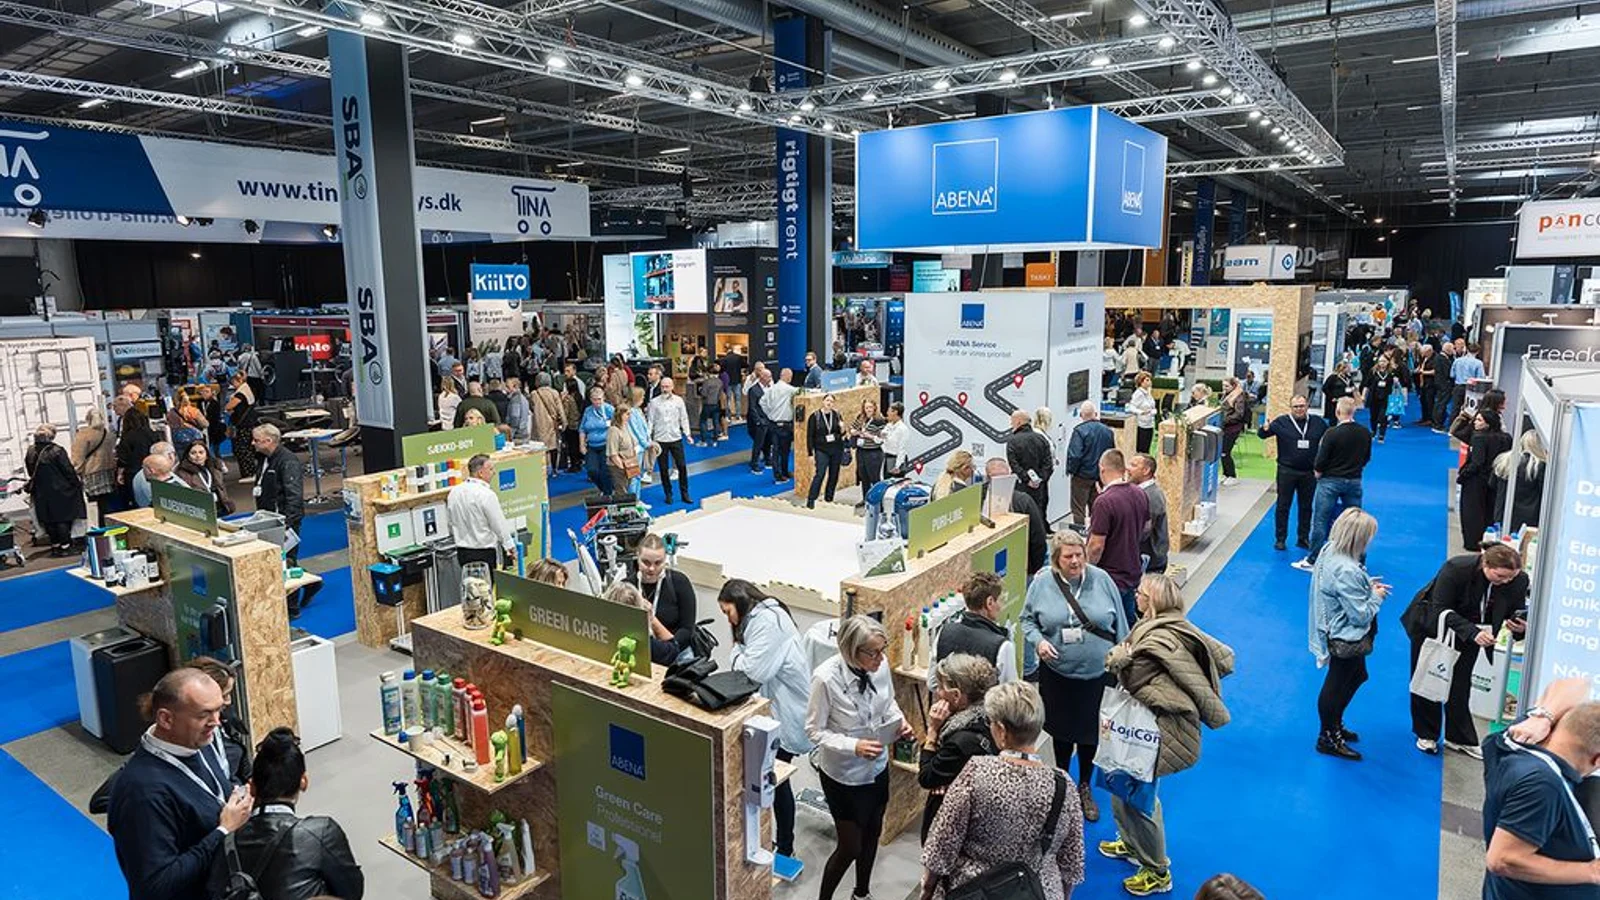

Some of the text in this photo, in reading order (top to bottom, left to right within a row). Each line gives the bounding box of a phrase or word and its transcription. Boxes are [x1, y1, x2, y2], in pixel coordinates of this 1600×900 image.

[342, 95, 363, 180] SBA
[511, 185, 556, 217] TINA
[782, 140, 800, 259] rigtigt rent
[935, 188, 993, 209] ABENA
[357, 286, 378, 365] SBA
[946, 340, 997, 349] ABENA Service
[1567, 557, 1599, 574] har
[1565, 575, 1596, 593] 100
[529, 605, 609, 645] GREEN CARE
[1559, 613, 1593, 628] gør
[611, 755, 644, 776] ABENA
[595, 785, 663, 824] Green Care
